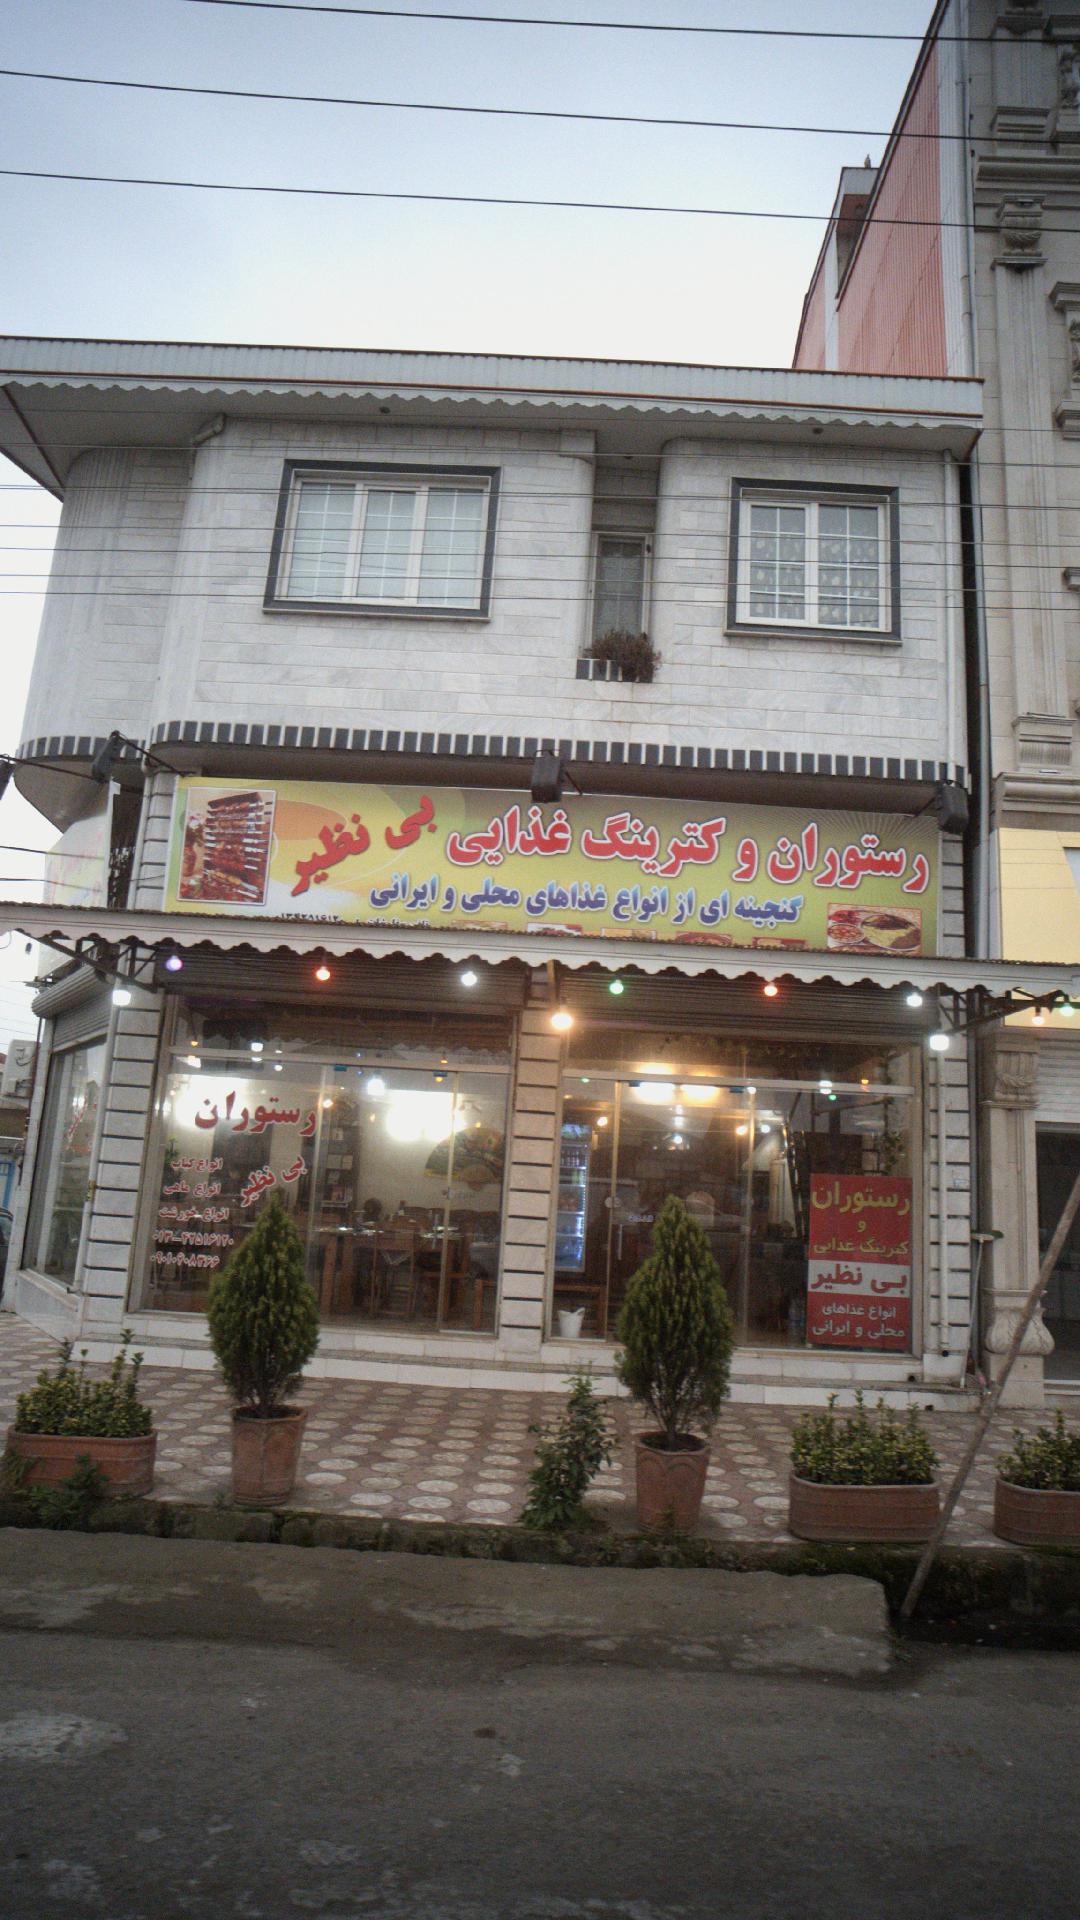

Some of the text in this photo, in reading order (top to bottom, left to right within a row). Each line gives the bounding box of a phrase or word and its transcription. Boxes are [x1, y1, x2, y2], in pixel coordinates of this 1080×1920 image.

[290, 795, 438, 897] بی نظیر
[446, 804, 930, 893] رستوران و کترینگ غذایی
[369, 872, 438, 909] ایرانی
[442, 885, 457, 911] و
[460, 874, 519, 912] محلی
[525, 878, 609, 915] غذاهای
[611, 883, 670, 924] انواع
[669, 886, 696, 924] از
[697, 888, 731, 926] ای
[194, 1090, 317, 1137] رستوران
[196, 1157, 224, 1173] انواع
[240, 1155, 307, 1207] بی نظیر
[162, 1180, 222, 1198] انواع ماهی
[811, 1181, 911, 1216] رستوران
[201, 1207, 230, 1222] انواع
[857, 1220, 867, 1233] و
[810, 1263, 908, 1294] بی نظیر
[812, 1319, 905, 1340] محلی و ایرانی
[868, 1306, 897, 1320] انواع
